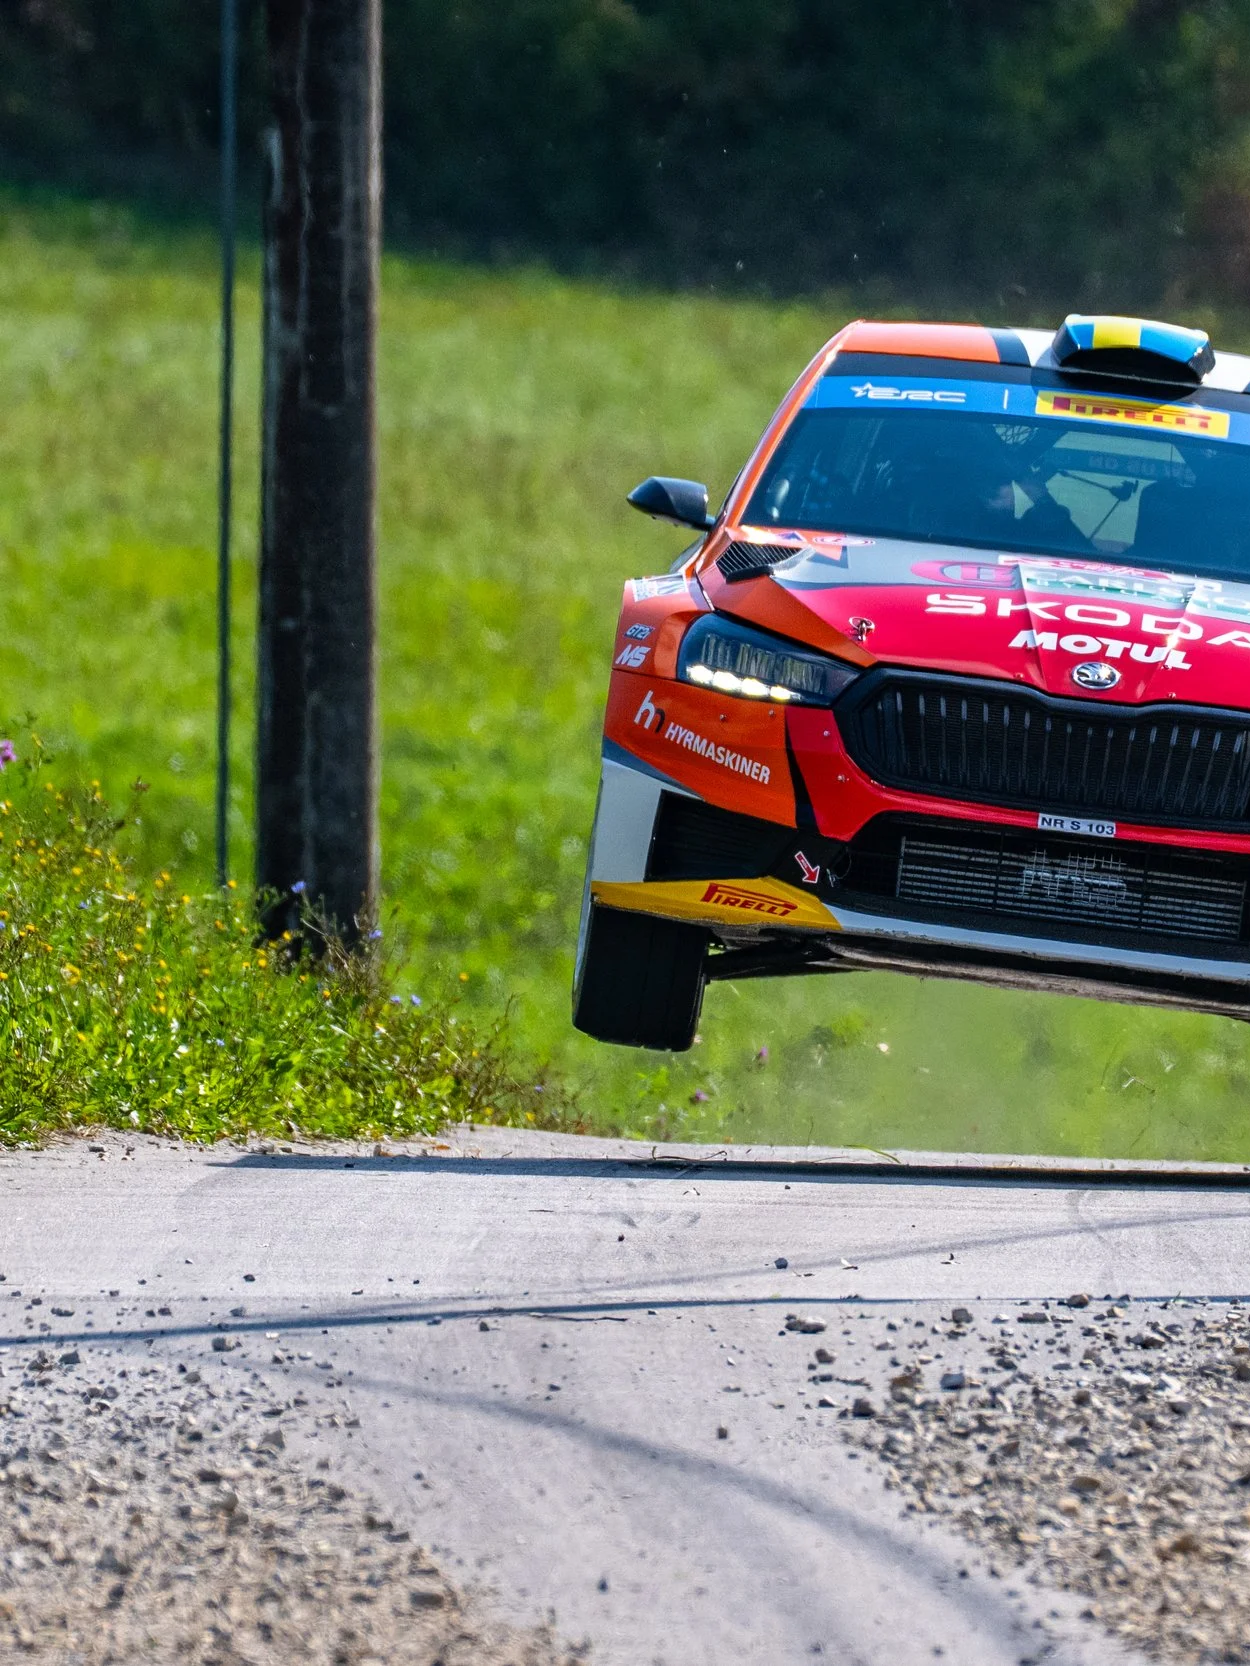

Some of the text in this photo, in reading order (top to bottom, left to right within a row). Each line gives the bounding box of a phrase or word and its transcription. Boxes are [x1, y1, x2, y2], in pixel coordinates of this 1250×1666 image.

[867, 388, 966, 403] ERC
[1052, 395, 1213, 430] PIRELLI
[1007, 629, 1193, 670] MOTUL
[664, 722, 771, 785] HYRMASKINER
[1040, 816, 1115, 836] NR S 103
[700, 882, 798, 917] PIRELLI
